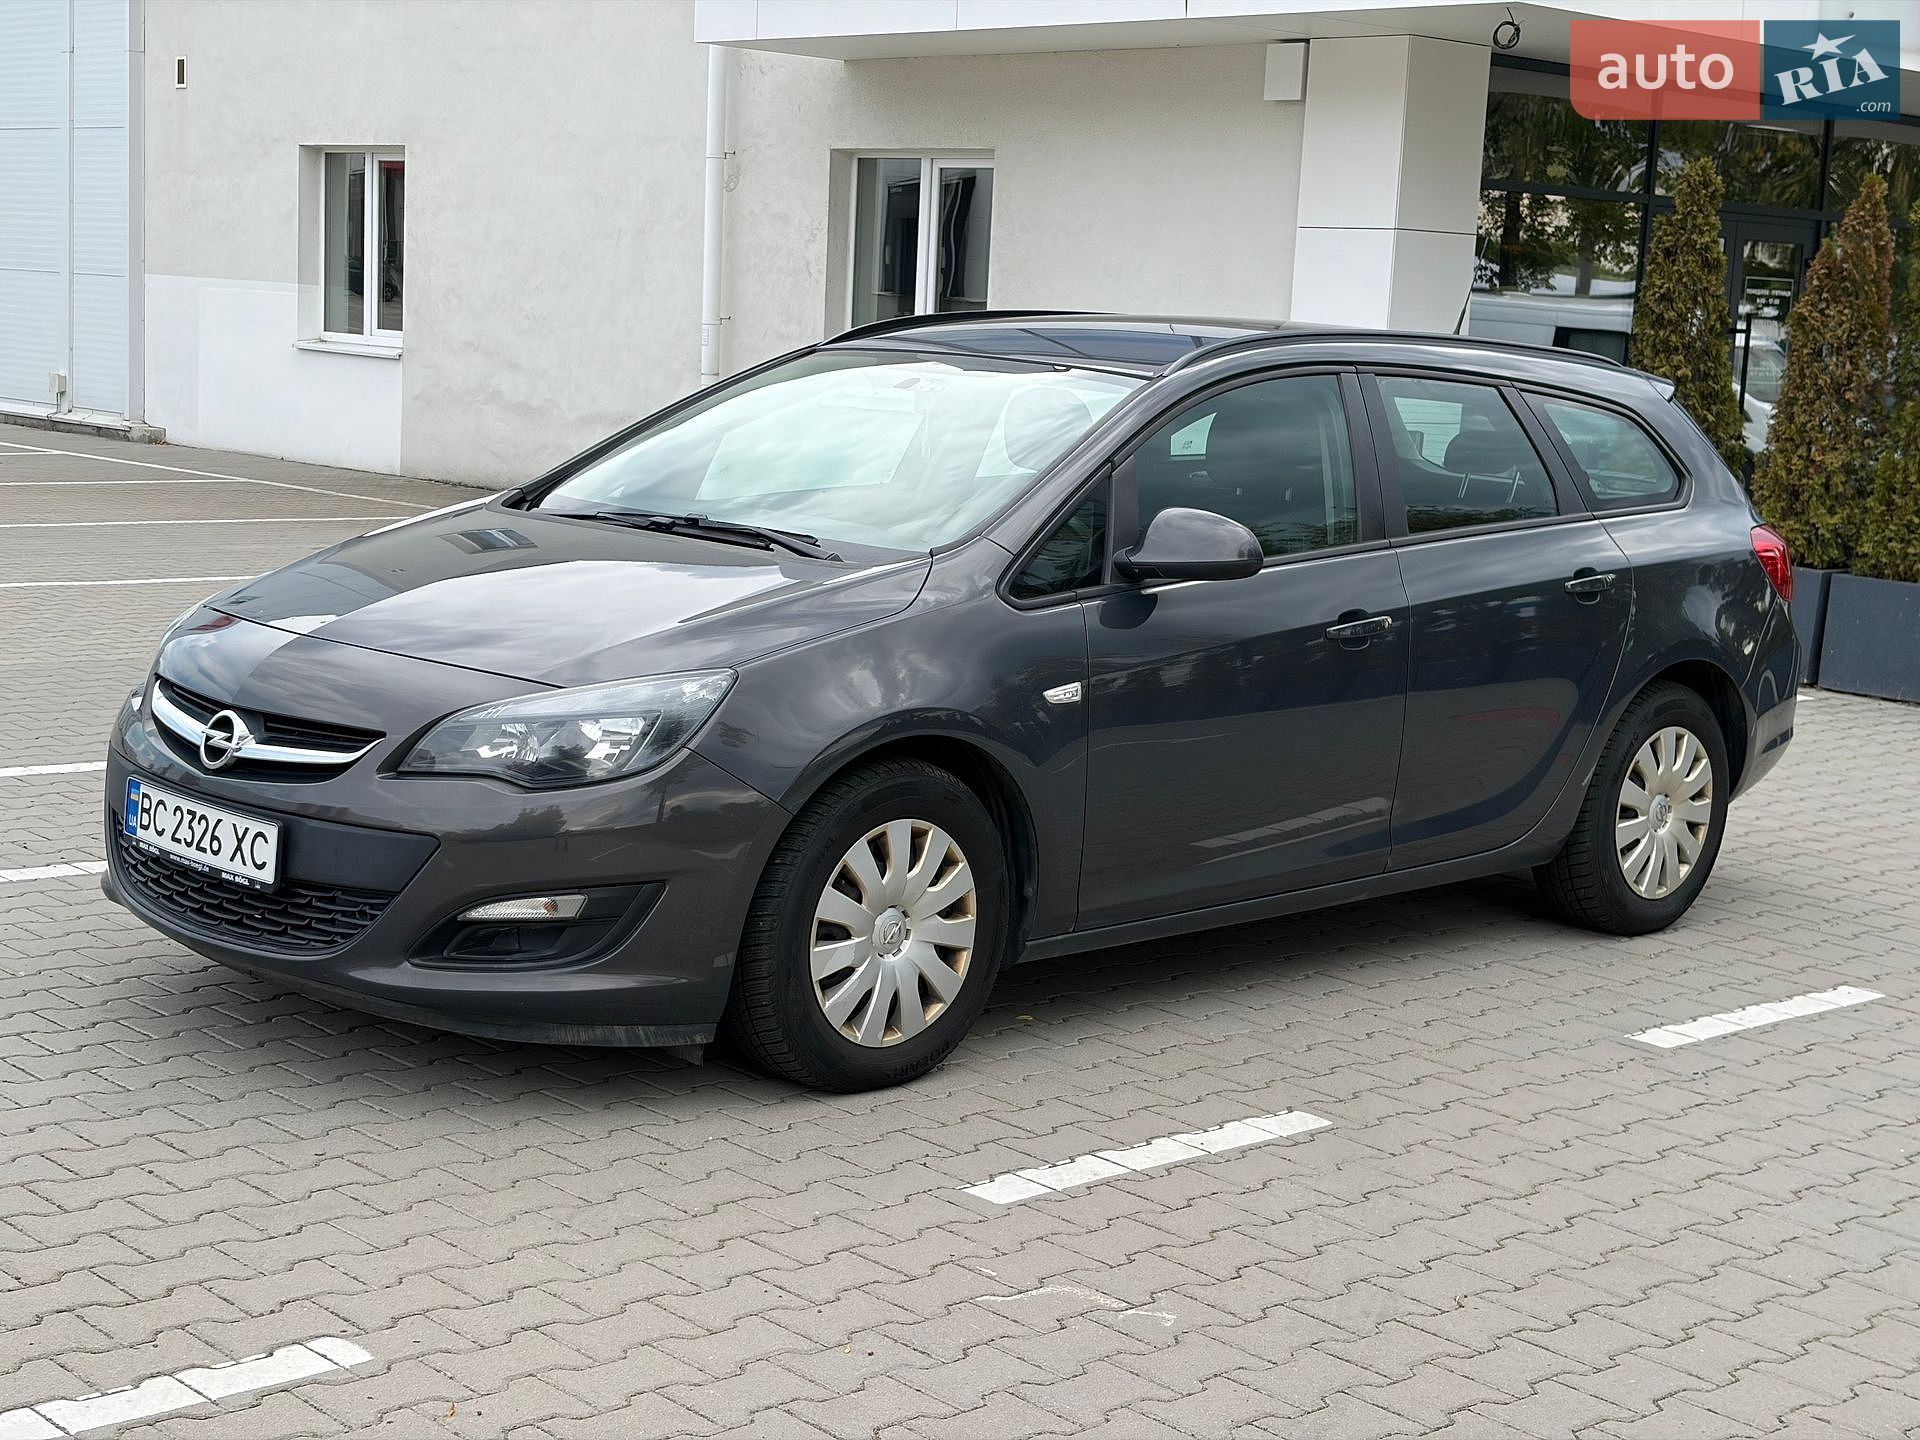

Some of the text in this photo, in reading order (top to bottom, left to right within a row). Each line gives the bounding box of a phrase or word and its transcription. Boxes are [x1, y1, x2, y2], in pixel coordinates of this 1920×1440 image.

[128, 814, 137, 827] UA
[139, 791, 269, 871] BC 2326 XC
[221, 871, 235, 882] MAX
